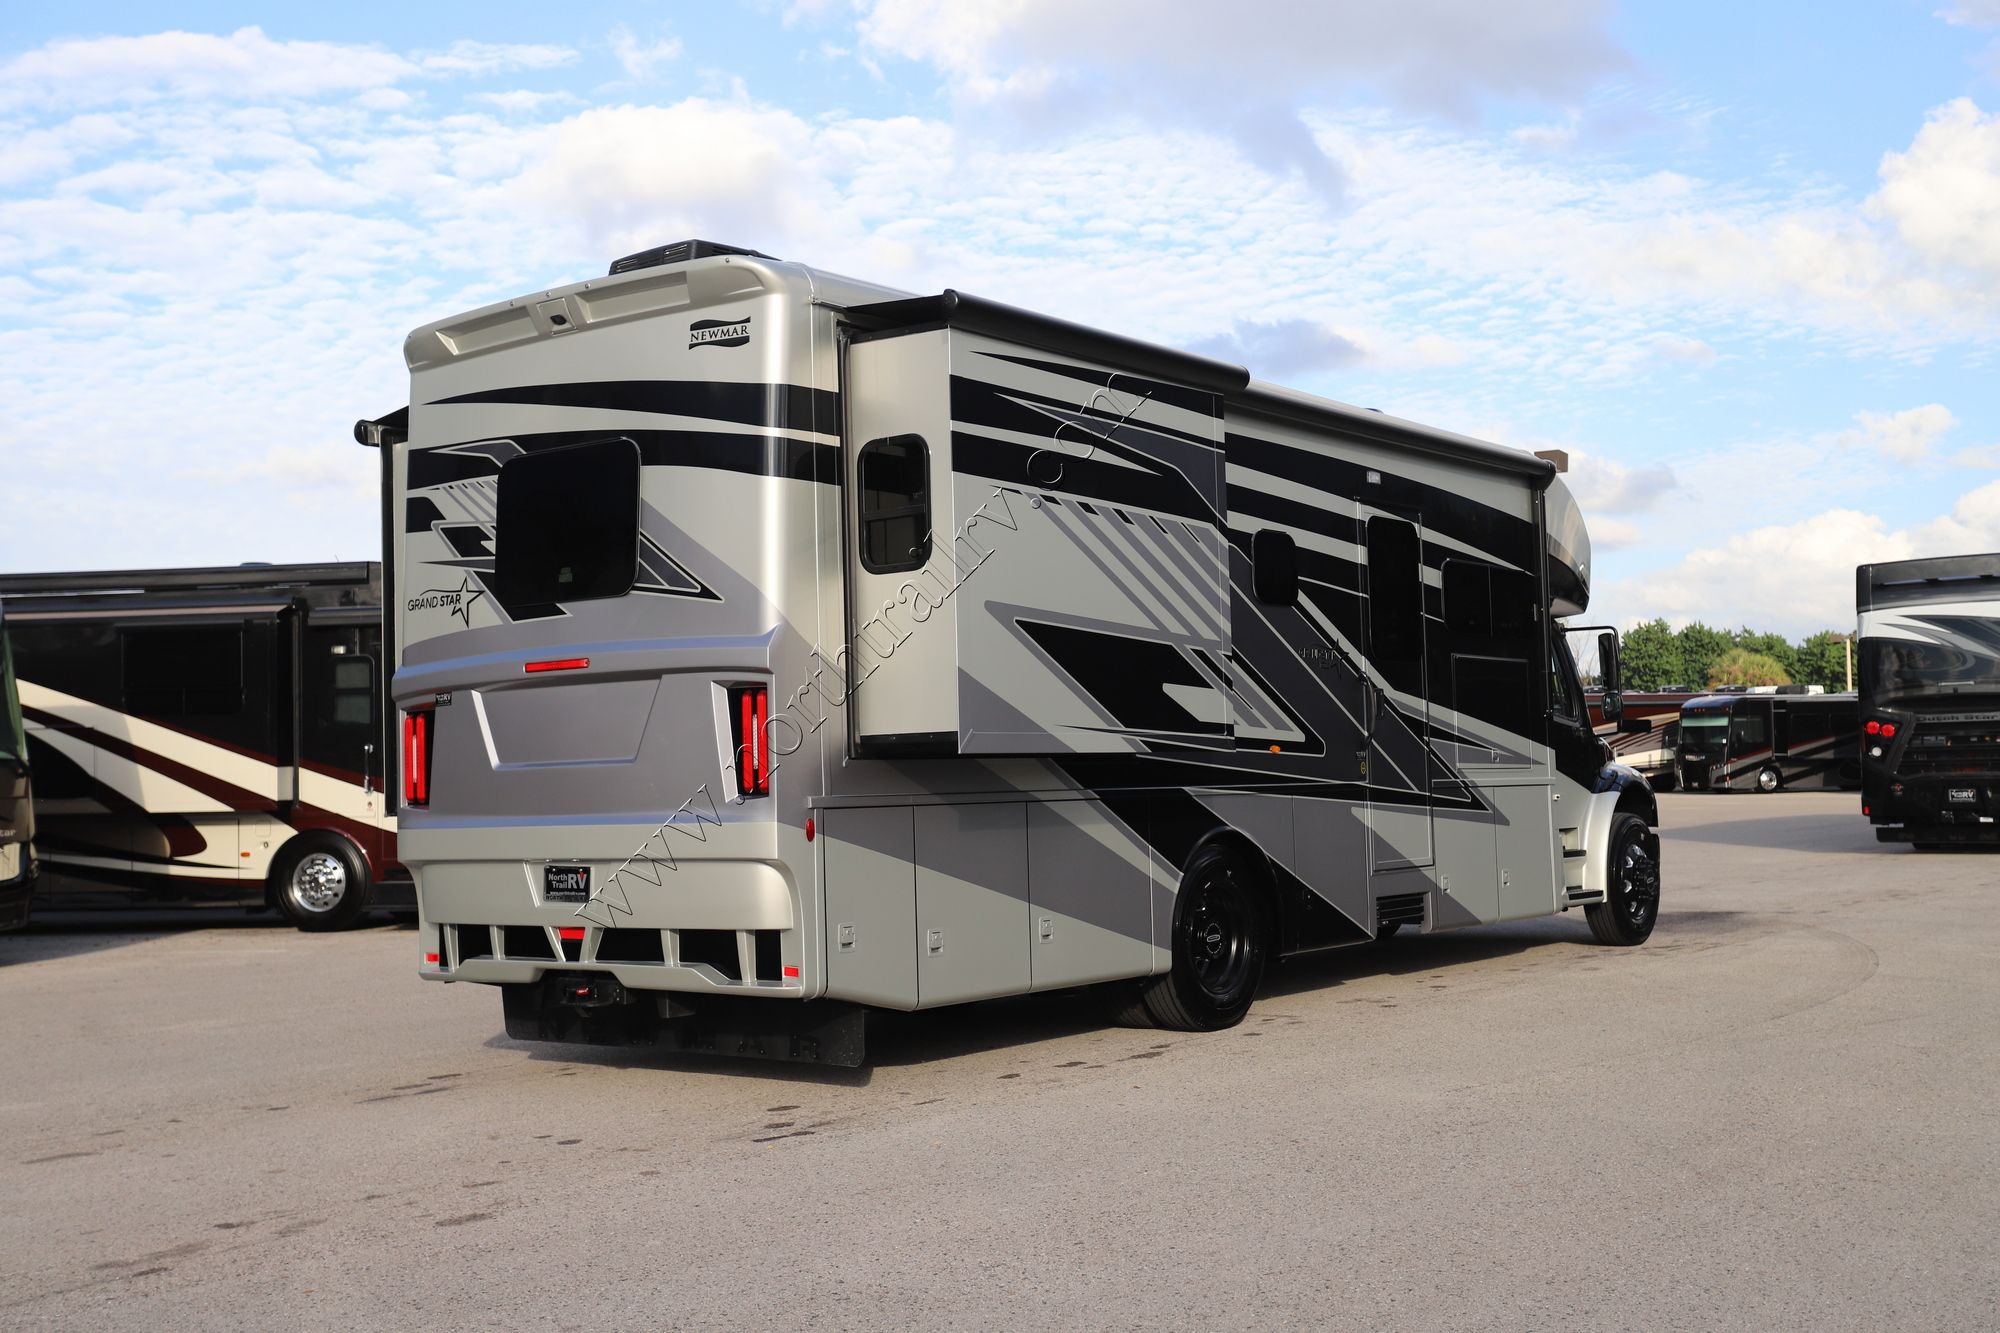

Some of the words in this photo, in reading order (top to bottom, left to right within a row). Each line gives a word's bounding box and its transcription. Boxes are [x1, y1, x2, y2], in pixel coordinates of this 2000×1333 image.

[690, 325, 749, 342] NEWMAR
[407, 596, 439, 611] GRAND
[439, 593, 461, 606] STAR
[548, 873, 568, 881] North
[551, 881, 568, 889] Trail
[567, 873, 587, 889] RV
